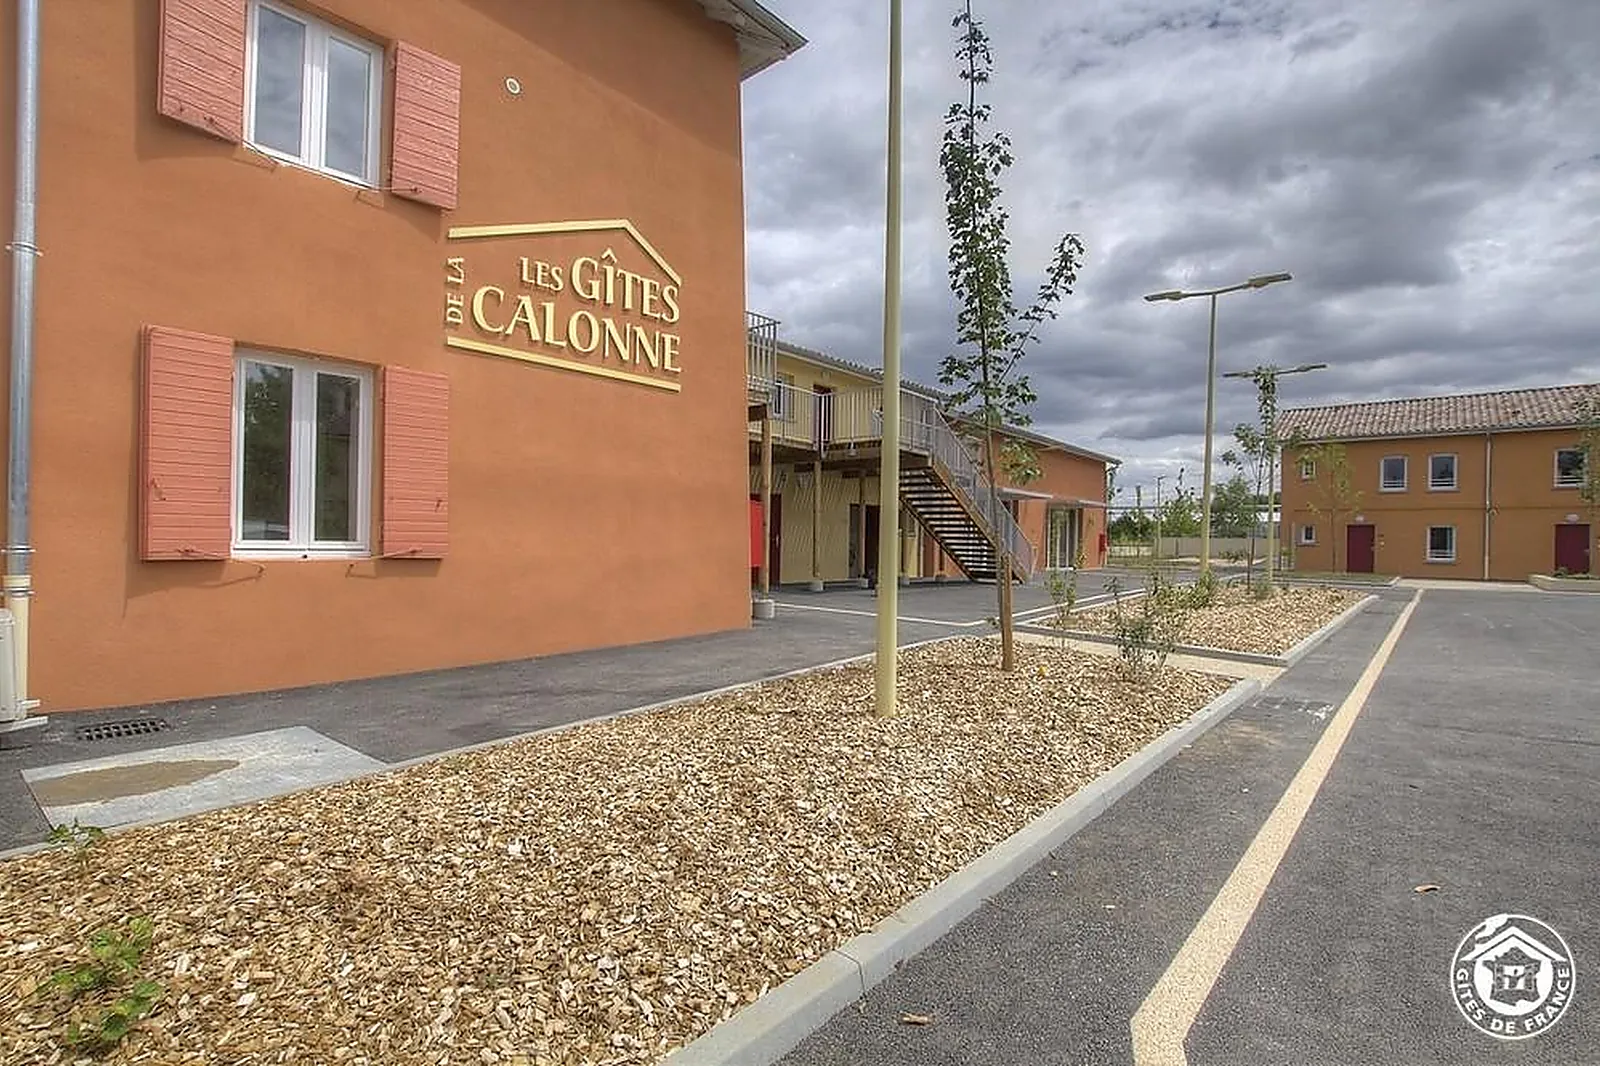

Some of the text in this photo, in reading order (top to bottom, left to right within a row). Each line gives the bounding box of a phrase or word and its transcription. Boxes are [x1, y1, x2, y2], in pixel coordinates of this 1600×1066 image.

[446, 256, 465, 324] DE LA
[520, 247, 680, 323] LES GÎTES
[472, 285, 682, 372] CALONNE
